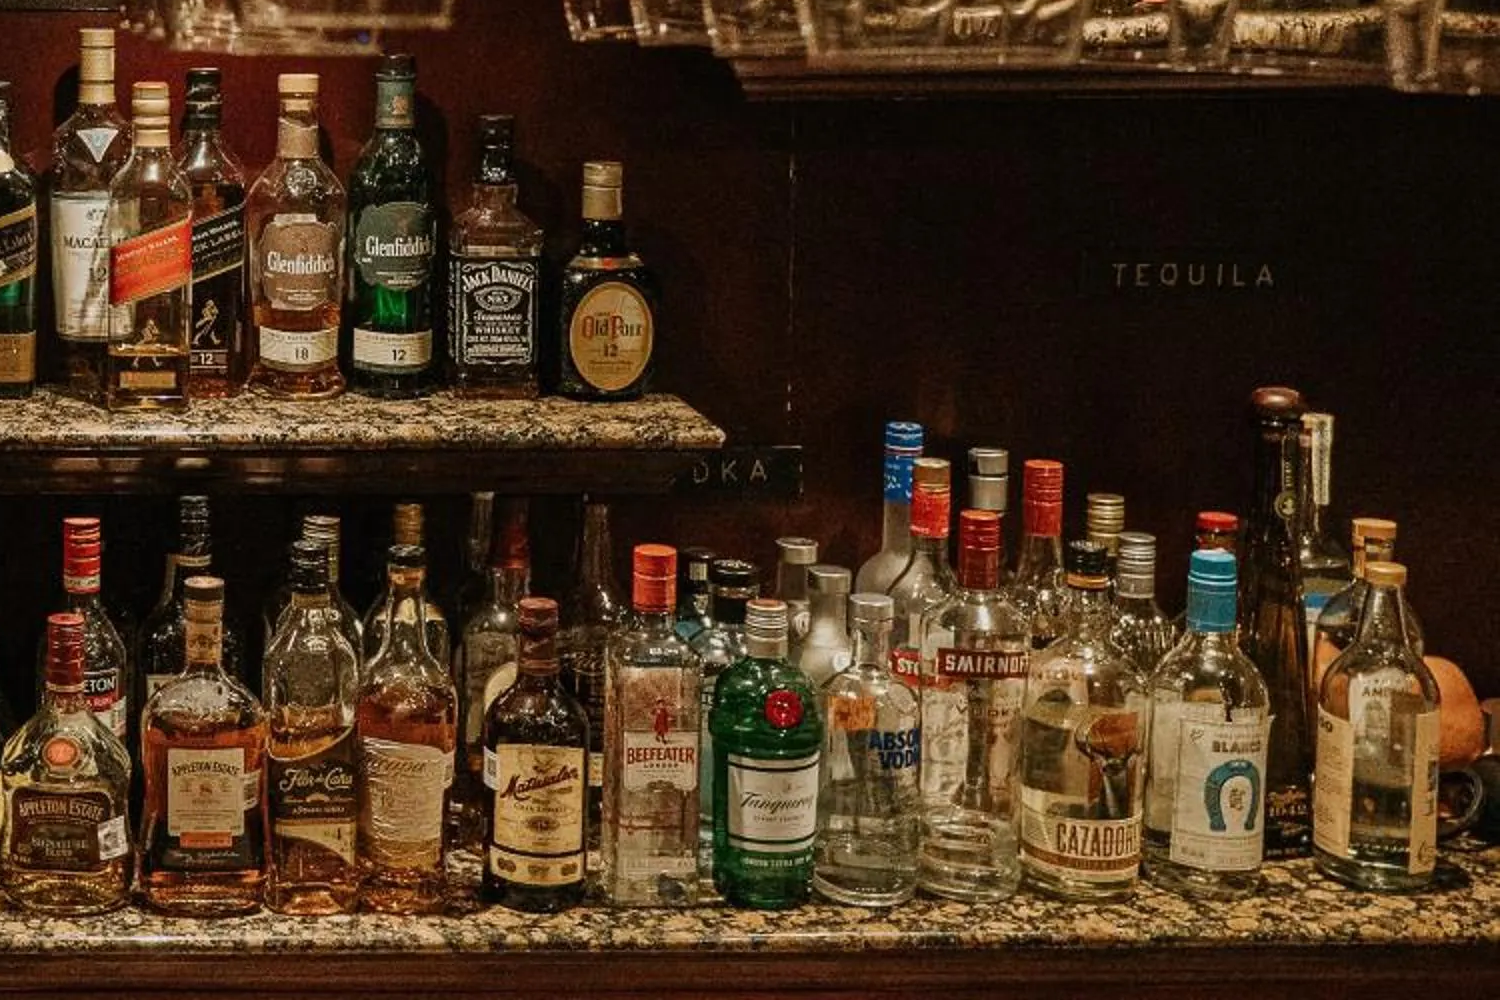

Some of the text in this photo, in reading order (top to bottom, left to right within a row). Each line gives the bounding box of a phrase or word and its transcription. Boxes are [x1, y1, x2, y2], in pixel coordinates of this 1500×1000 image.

[365, 234, 431, 257] Glenfiddich
[267, 250, 335, 275] Glenfiddich
[462, 270, 491, 292] JACK
[1111, 263, 1274, 288] TEQUILA
[582, 315, 643, 341] Old Parr
[199, 353, 214, 365] 12
[294, 347, 309, 361] 18
[391, 349, 407, 361] 12
[604, 344, 619, 357] 12
[627, 747, 695, 765] BEEFEATER
